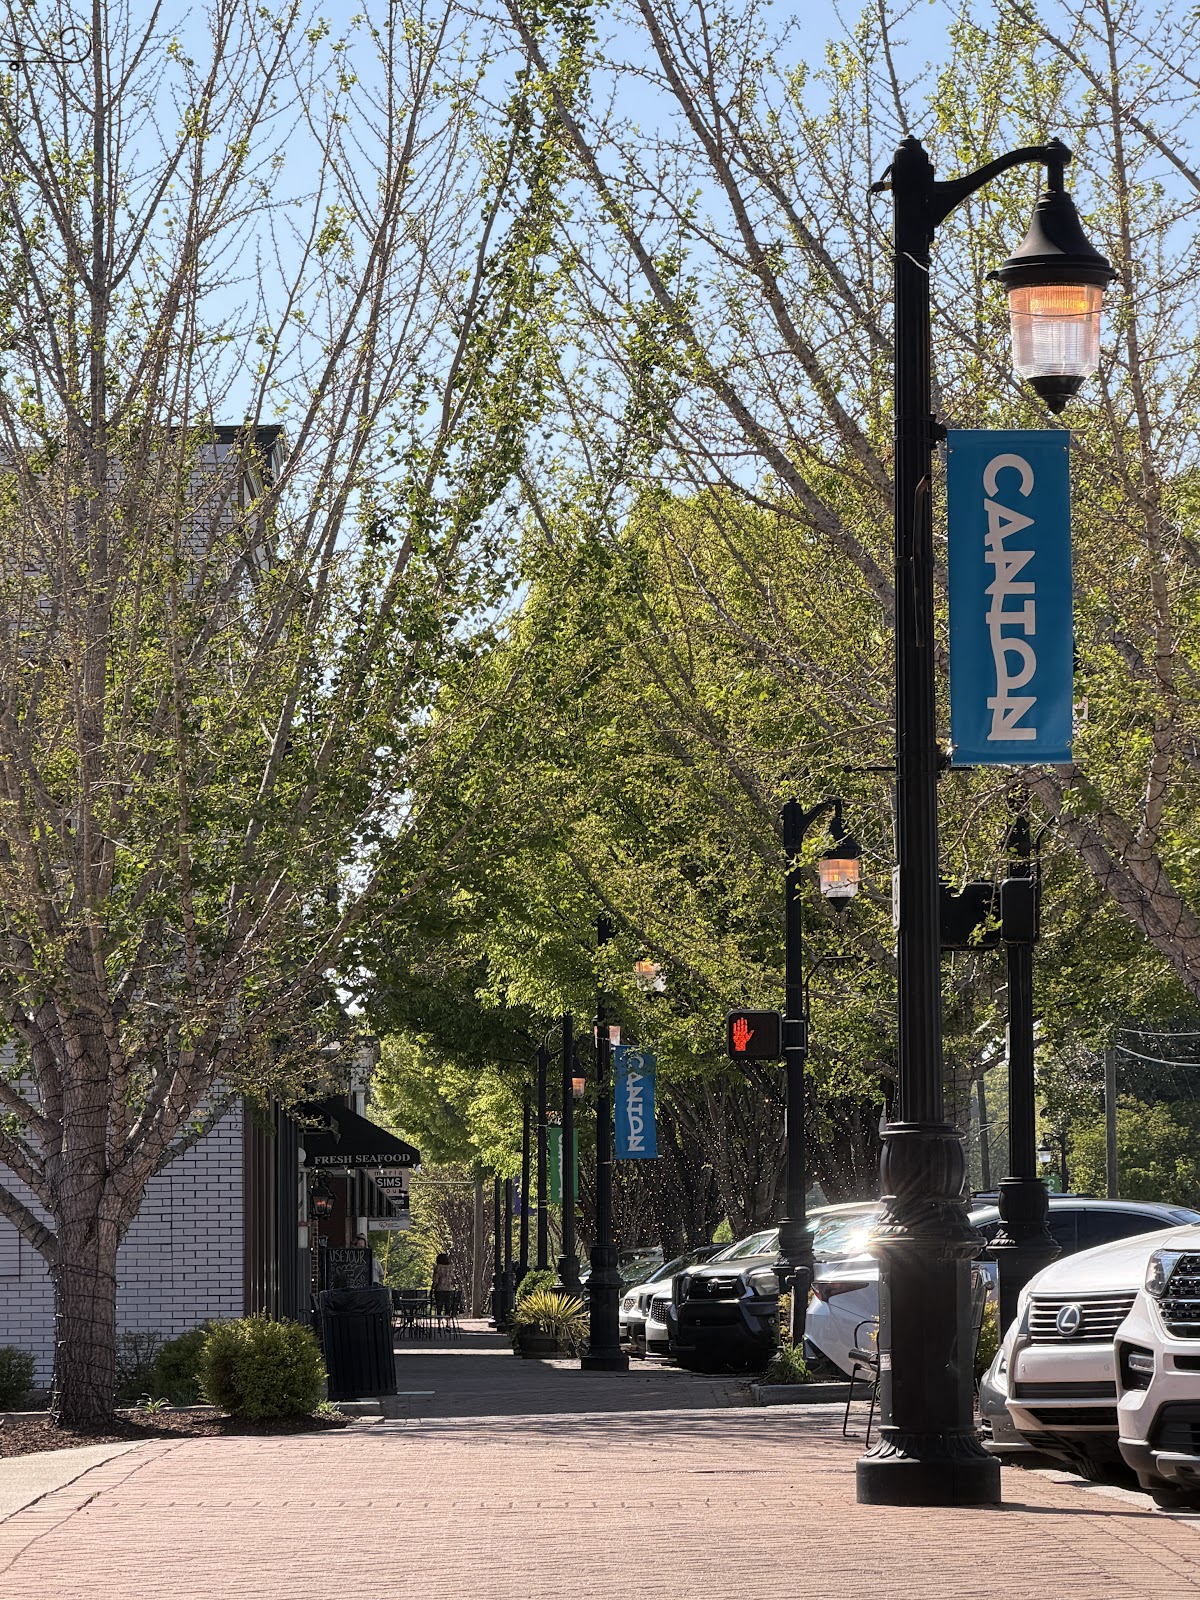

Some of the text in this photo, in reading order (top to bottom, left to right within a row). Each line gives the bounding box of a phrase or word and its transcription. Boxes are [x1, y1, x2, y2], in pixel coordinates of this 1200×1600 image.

[983, 453, 1037, 741] CANTON
[626, 1053, 645, 1152] CANTON
[314, 1153, 411, 1164] FRESH SEAFOOD
[377, 1178, 401, 1187] SIMS
